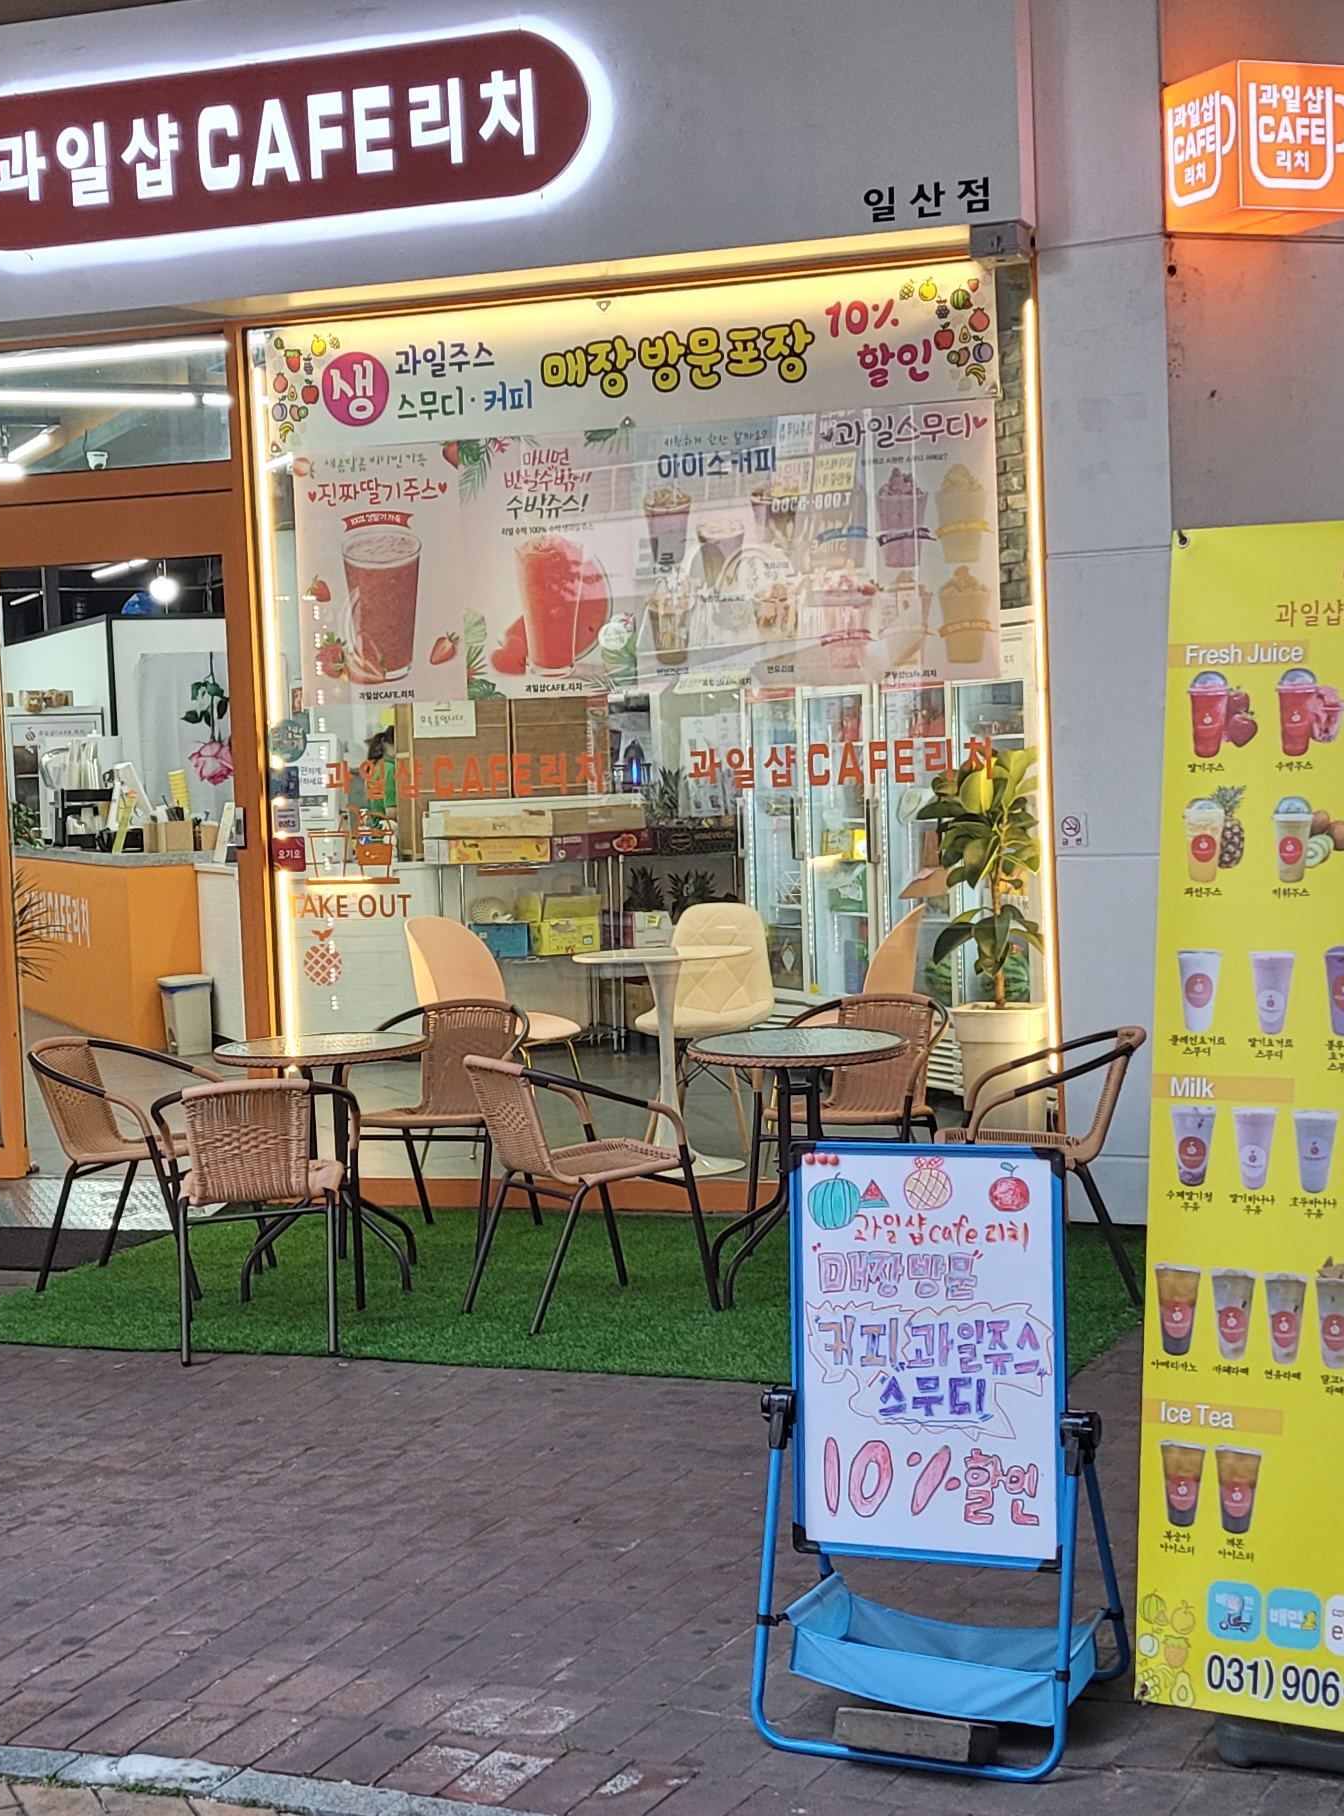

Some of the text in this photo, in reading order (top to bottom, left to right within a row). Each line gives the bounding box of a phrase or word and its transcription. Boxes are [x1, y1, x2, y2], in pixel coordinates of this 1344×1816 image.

[1173, 92, 1216, 129] 과일샵
[1258, 84, 1325, 114] 과일샵
[1173, 124, 1216, 165] CAFE
[1258, 115, 1326, 146] CAFE
[1183, 161, 1207, 187] 리치
[1275, 150, 1310, 173] 리치
[863, 177, 991, 223] 일산점
[825, 298, 900, 339] 10%
[328, 318, 935, 421] 생 과일주스 매장 방문포장 할인
[656, 446, 777, 480] 아이스커피
[1184, 641, 1305, 665] Fresh Juice
[358, 894, 412, 918] OUT
[1169, 1076, 1216, 1100] Milk
[1159, 1401, 1235, 1429] Ice Tea
[963, 1448, 1039, 1526] 할인
